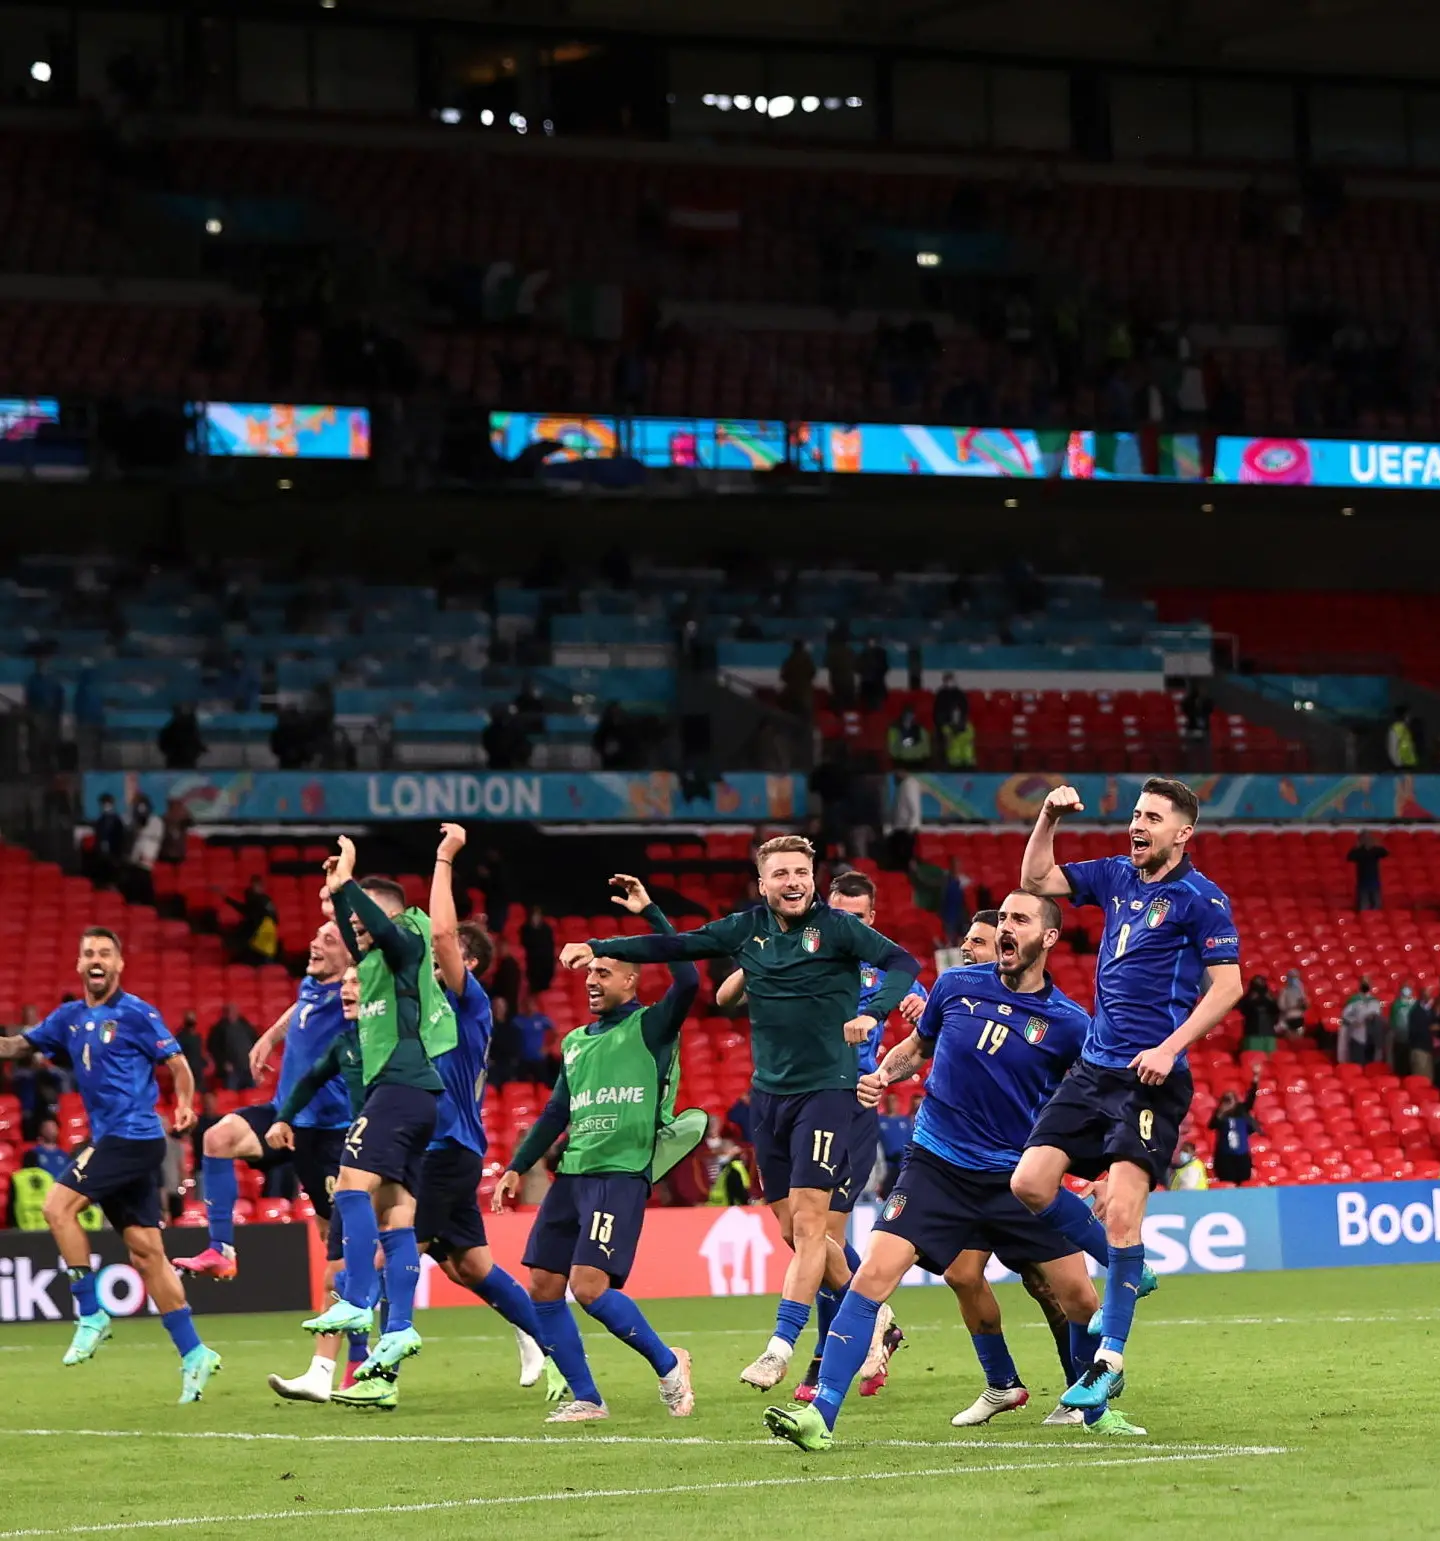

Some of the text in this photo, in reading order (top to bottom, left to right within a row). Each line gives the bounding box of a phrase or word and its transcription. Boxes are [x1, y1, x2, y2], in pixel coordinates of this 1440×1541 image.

[367, 776, 541, 815] LONDON
[976, 1019, 1010, 1056] 19
[596, 1086, 645, 1105] GAME
[345, 1116, 368, 1145] 2
[1139, 1109, 1154, 1140] 8
[812, 1129, 835, 1163] 17
[589, 1211, 615, 1245] 13
